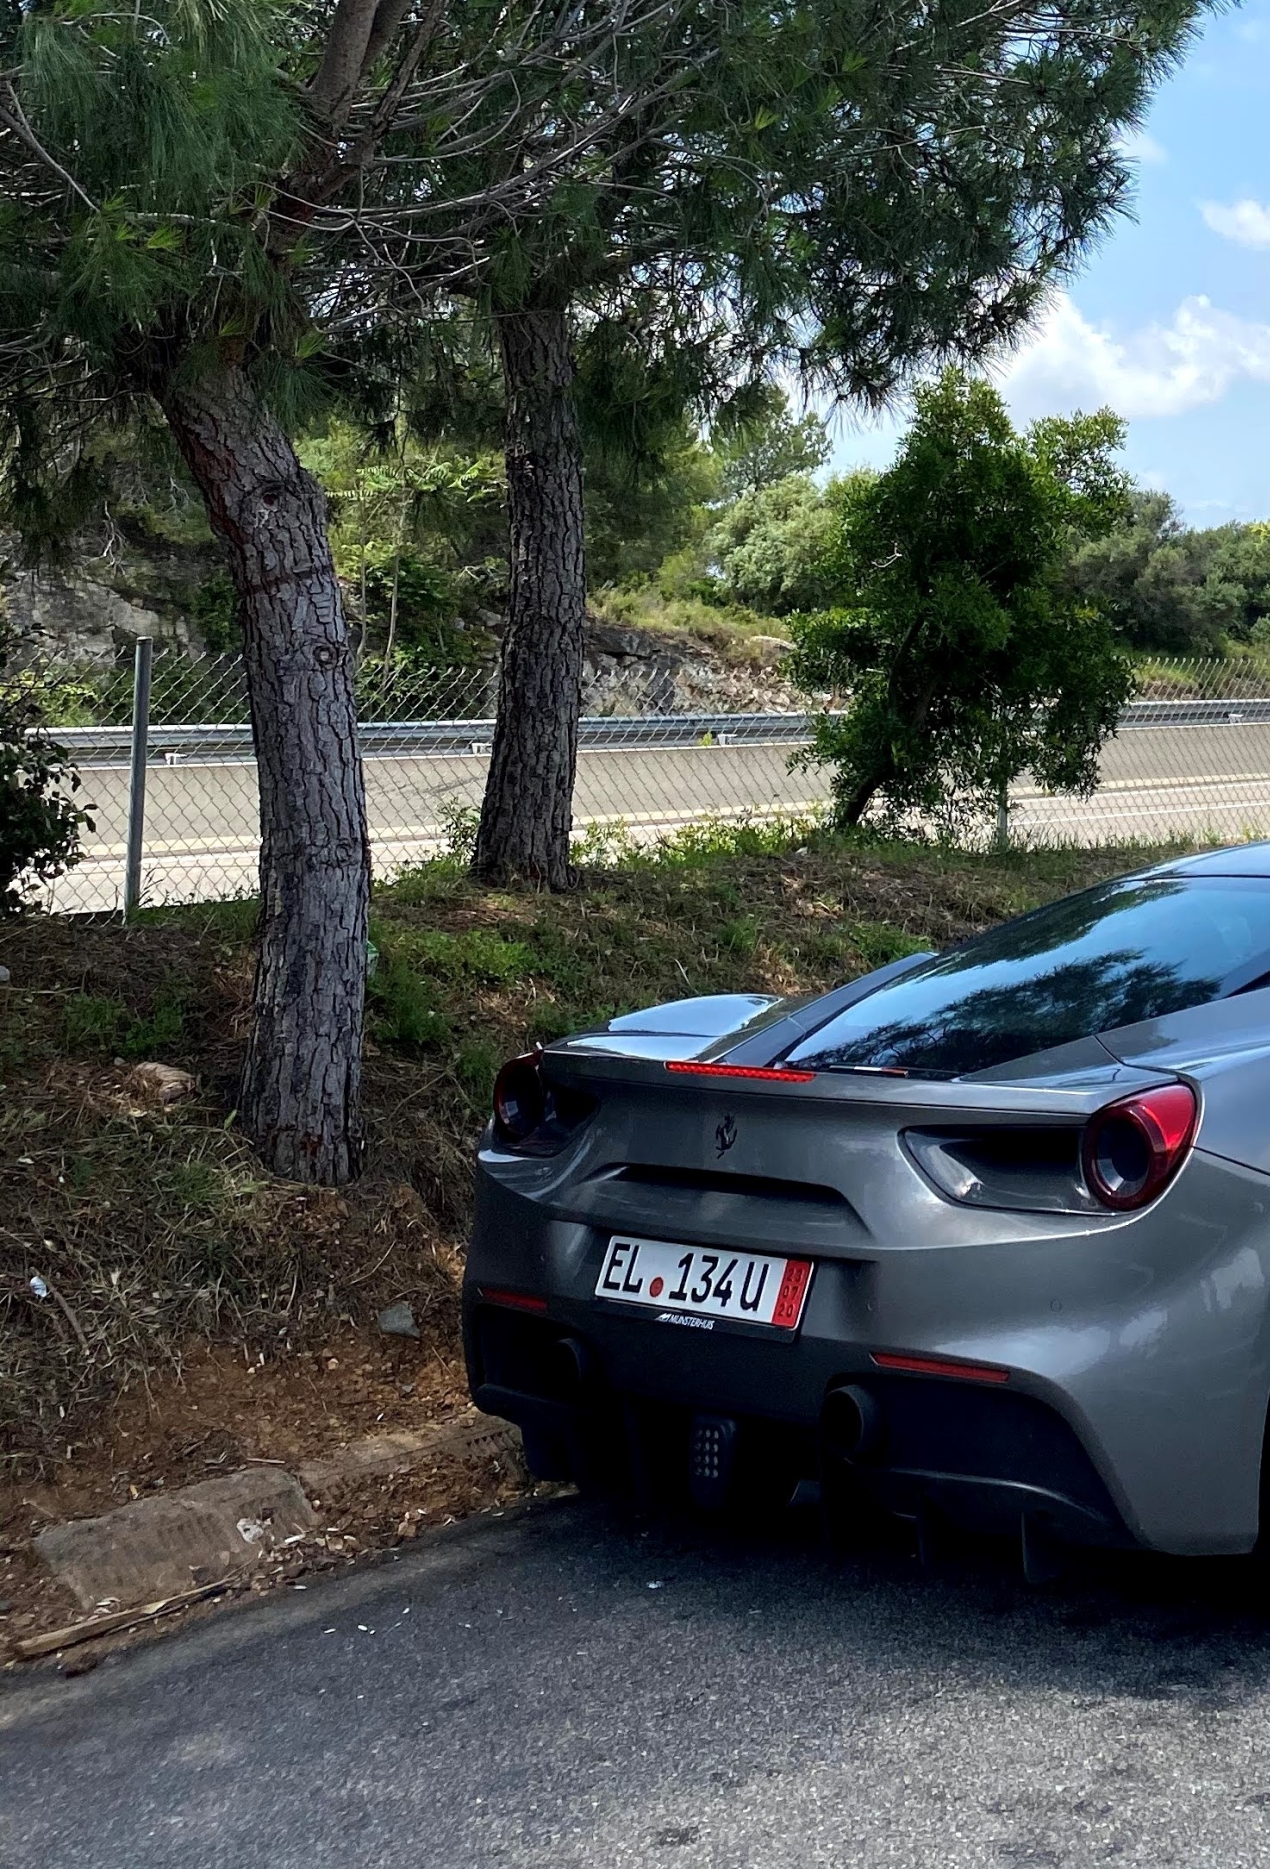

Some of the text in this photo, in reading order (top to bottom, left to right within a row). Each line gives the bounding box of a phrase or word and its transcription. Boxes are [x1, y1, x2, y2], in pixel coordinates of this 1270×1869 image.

[603, 1243, 643, 1293] EL
[783, 1286, 798, 1300] 07
[778, 1303, 793, 1317] 20
